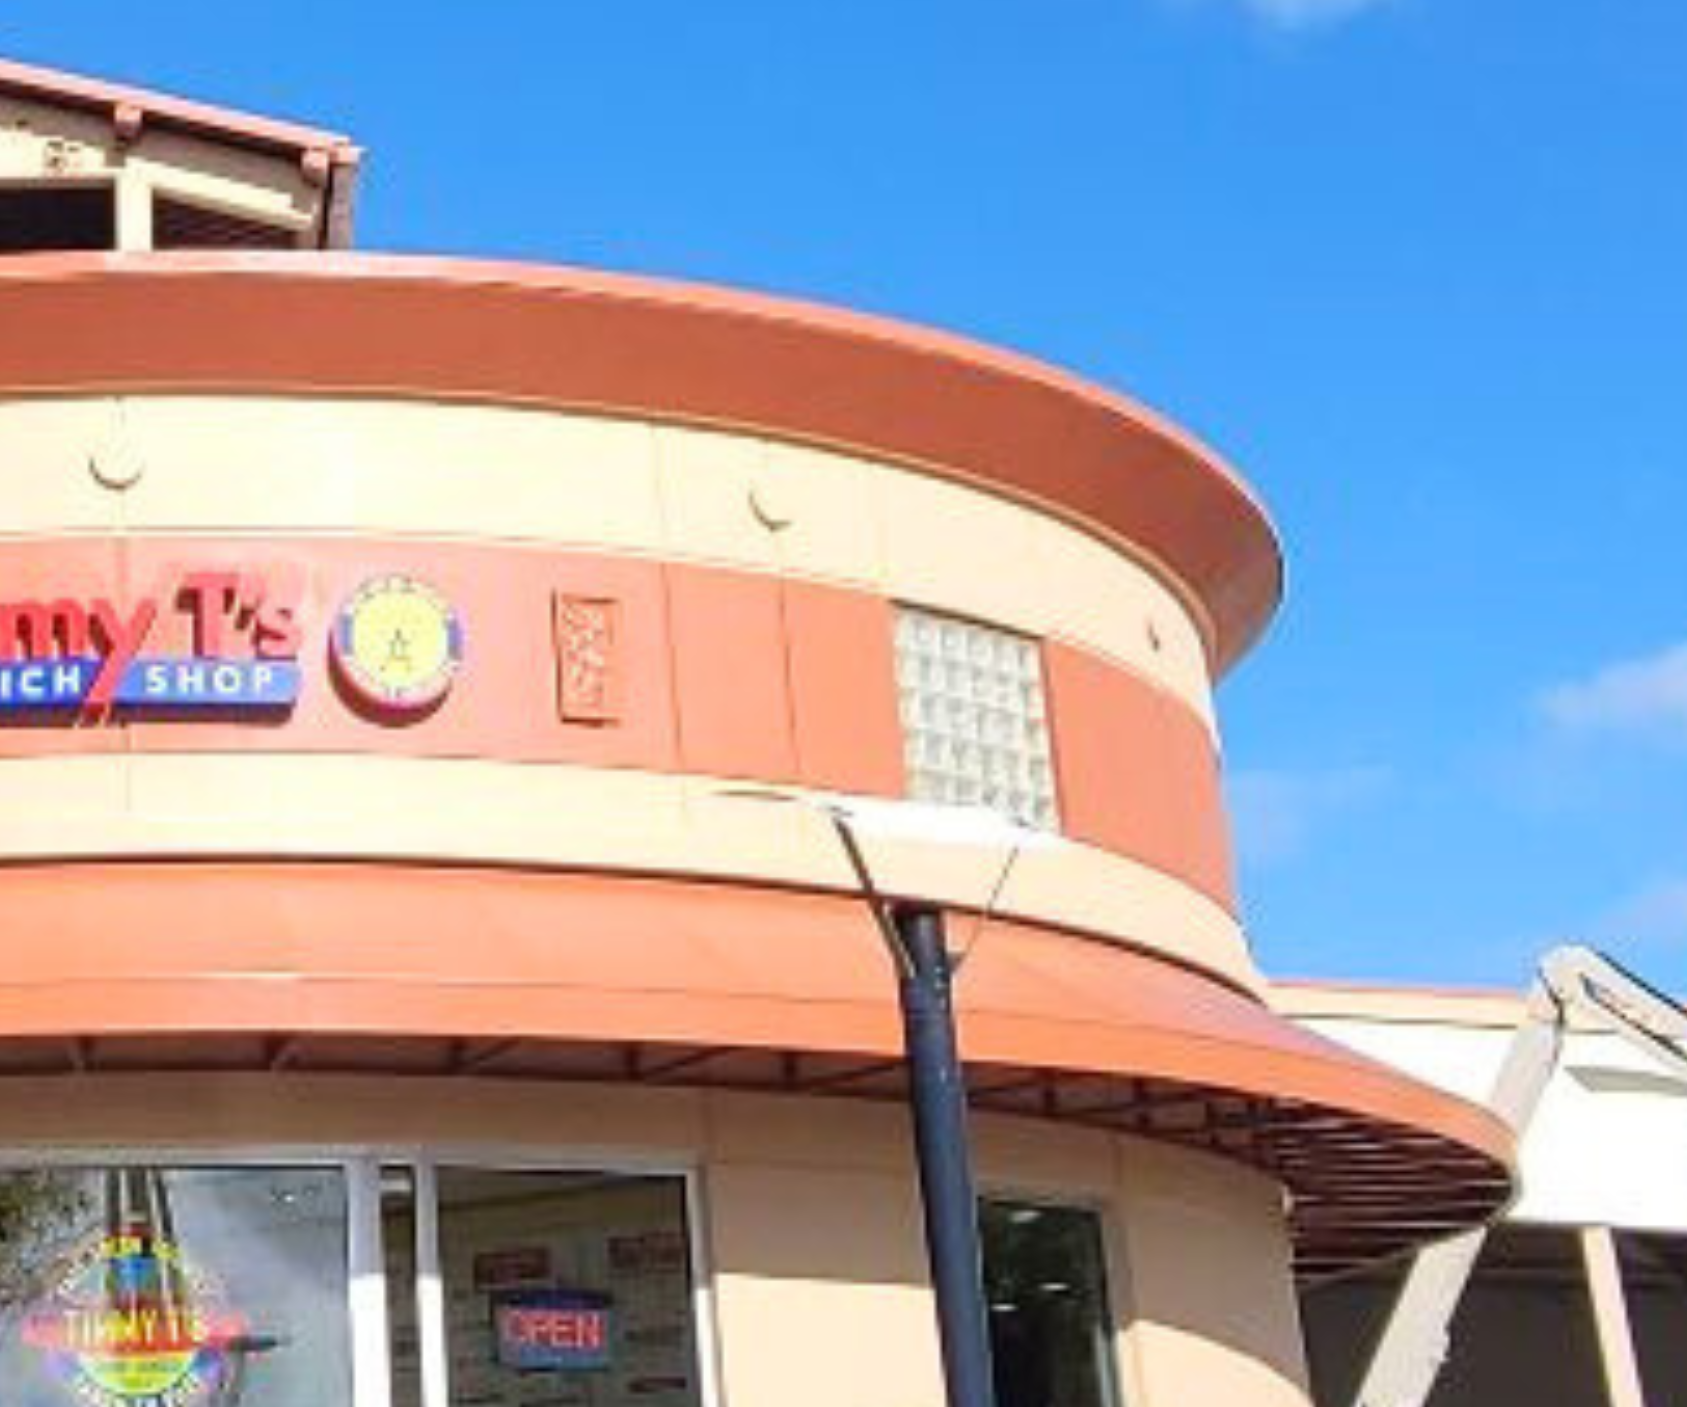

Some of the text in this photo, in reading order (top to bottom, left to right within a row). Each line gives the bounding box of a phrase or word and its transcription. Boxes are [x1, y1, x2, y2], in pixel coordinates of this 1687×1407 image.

[172, 570, 300, 660] T's
[145, 662, 276, 695] SHOP
[502, 1310, 601, 1348] OPEN
